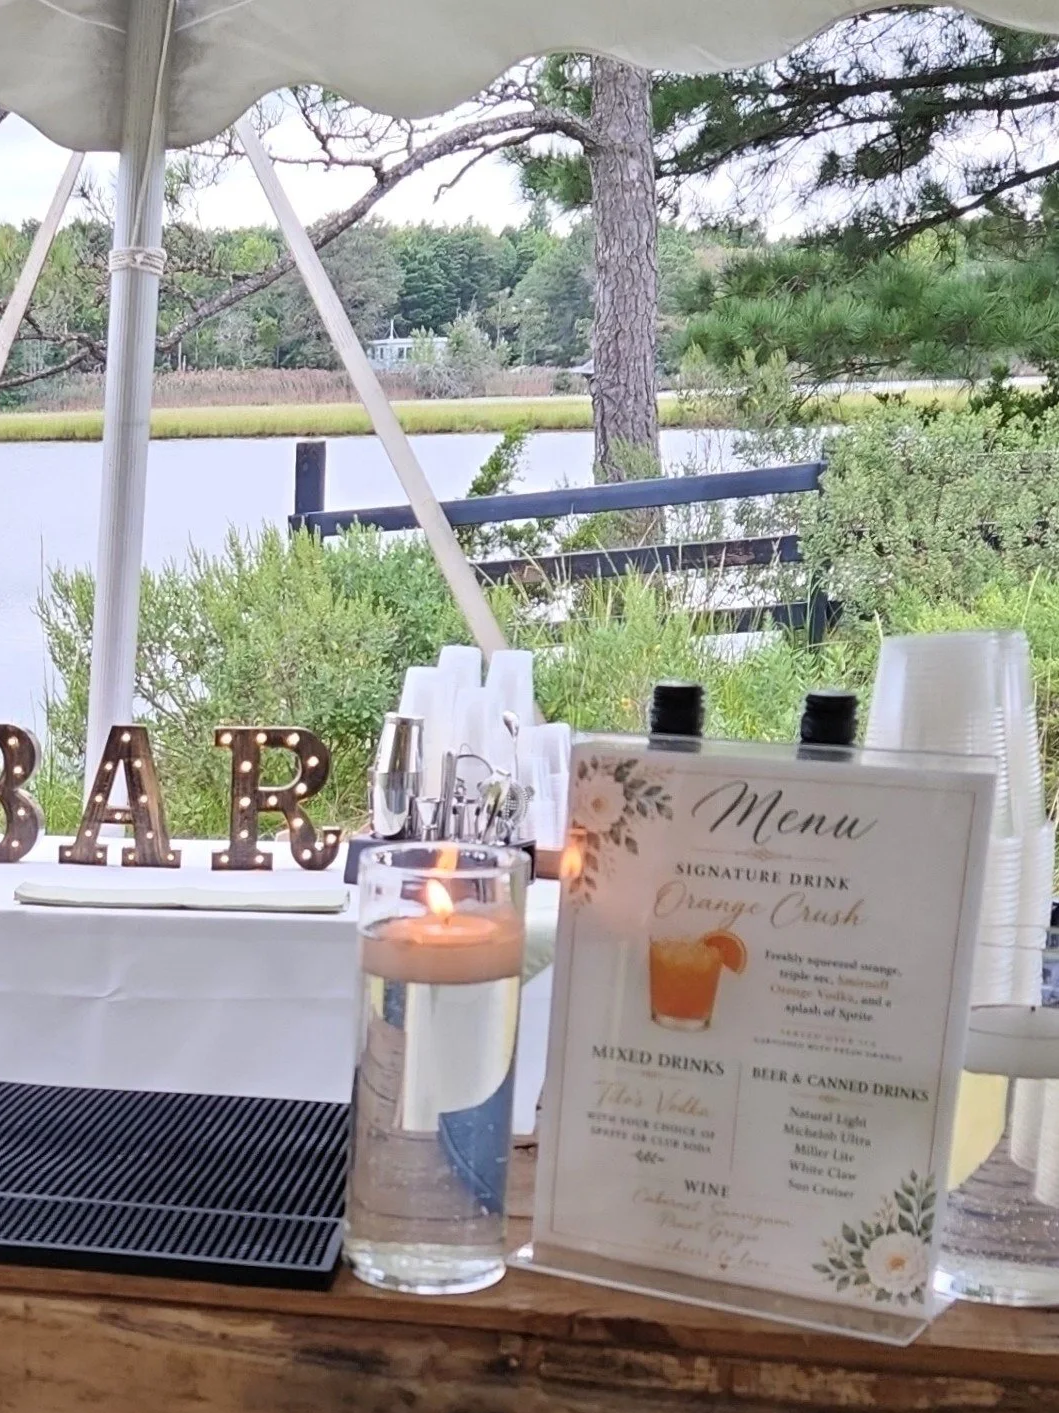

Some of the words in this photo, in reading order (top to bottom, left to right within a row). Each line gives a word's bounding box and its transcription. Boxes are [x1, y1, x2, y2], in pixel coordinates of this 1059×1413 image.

[692, 780, 877, 844] Menu
[675, 863, 781, 884] SIGNATURE
[790, 873, 850, 890] DRINK
[654, 880, 766, 928] Orange
[770, 892, 865, 929] Crush
[765, 949, 804, 965] Freshly
[807, 957, 858, 970] squeezed
[780, 969, 809, 982] triple
[785, 1002, 821, 1016] splash
[823, 1007, 835, 1018] of
[839, 1008, 873, 1022] Sprite
[861, 996, 882, 1007] and
[592, 1045, 652, 1065] MIXED
[658, 1053, 725, 1076] DRINKS
[752, 1066, 788, 1083] BEER
[792, 1073, 802, 1084] &
[807, 1074, 869, 1094] CANNED
[873, 1083, 929, 1101] DRINKS
[790, 1106, 833, 1122] Natural
[837, 1113, 867, 1129] Light
[784, 1123, 837, 1142] Michelob
[841, 1132, 871, 1147] Ultra
[794, 1142, 829, 1159] Miller
[833, 1148, 856, 1163] Lite
[789, 1159, 824, 1176] White
[828, 1167, 857, 1181] Claw
[683, 1178, 730, 1199] WINE
[788, 1179, 809, 1192] Sun
[812, 1184, 855, 1199] Cruiser
